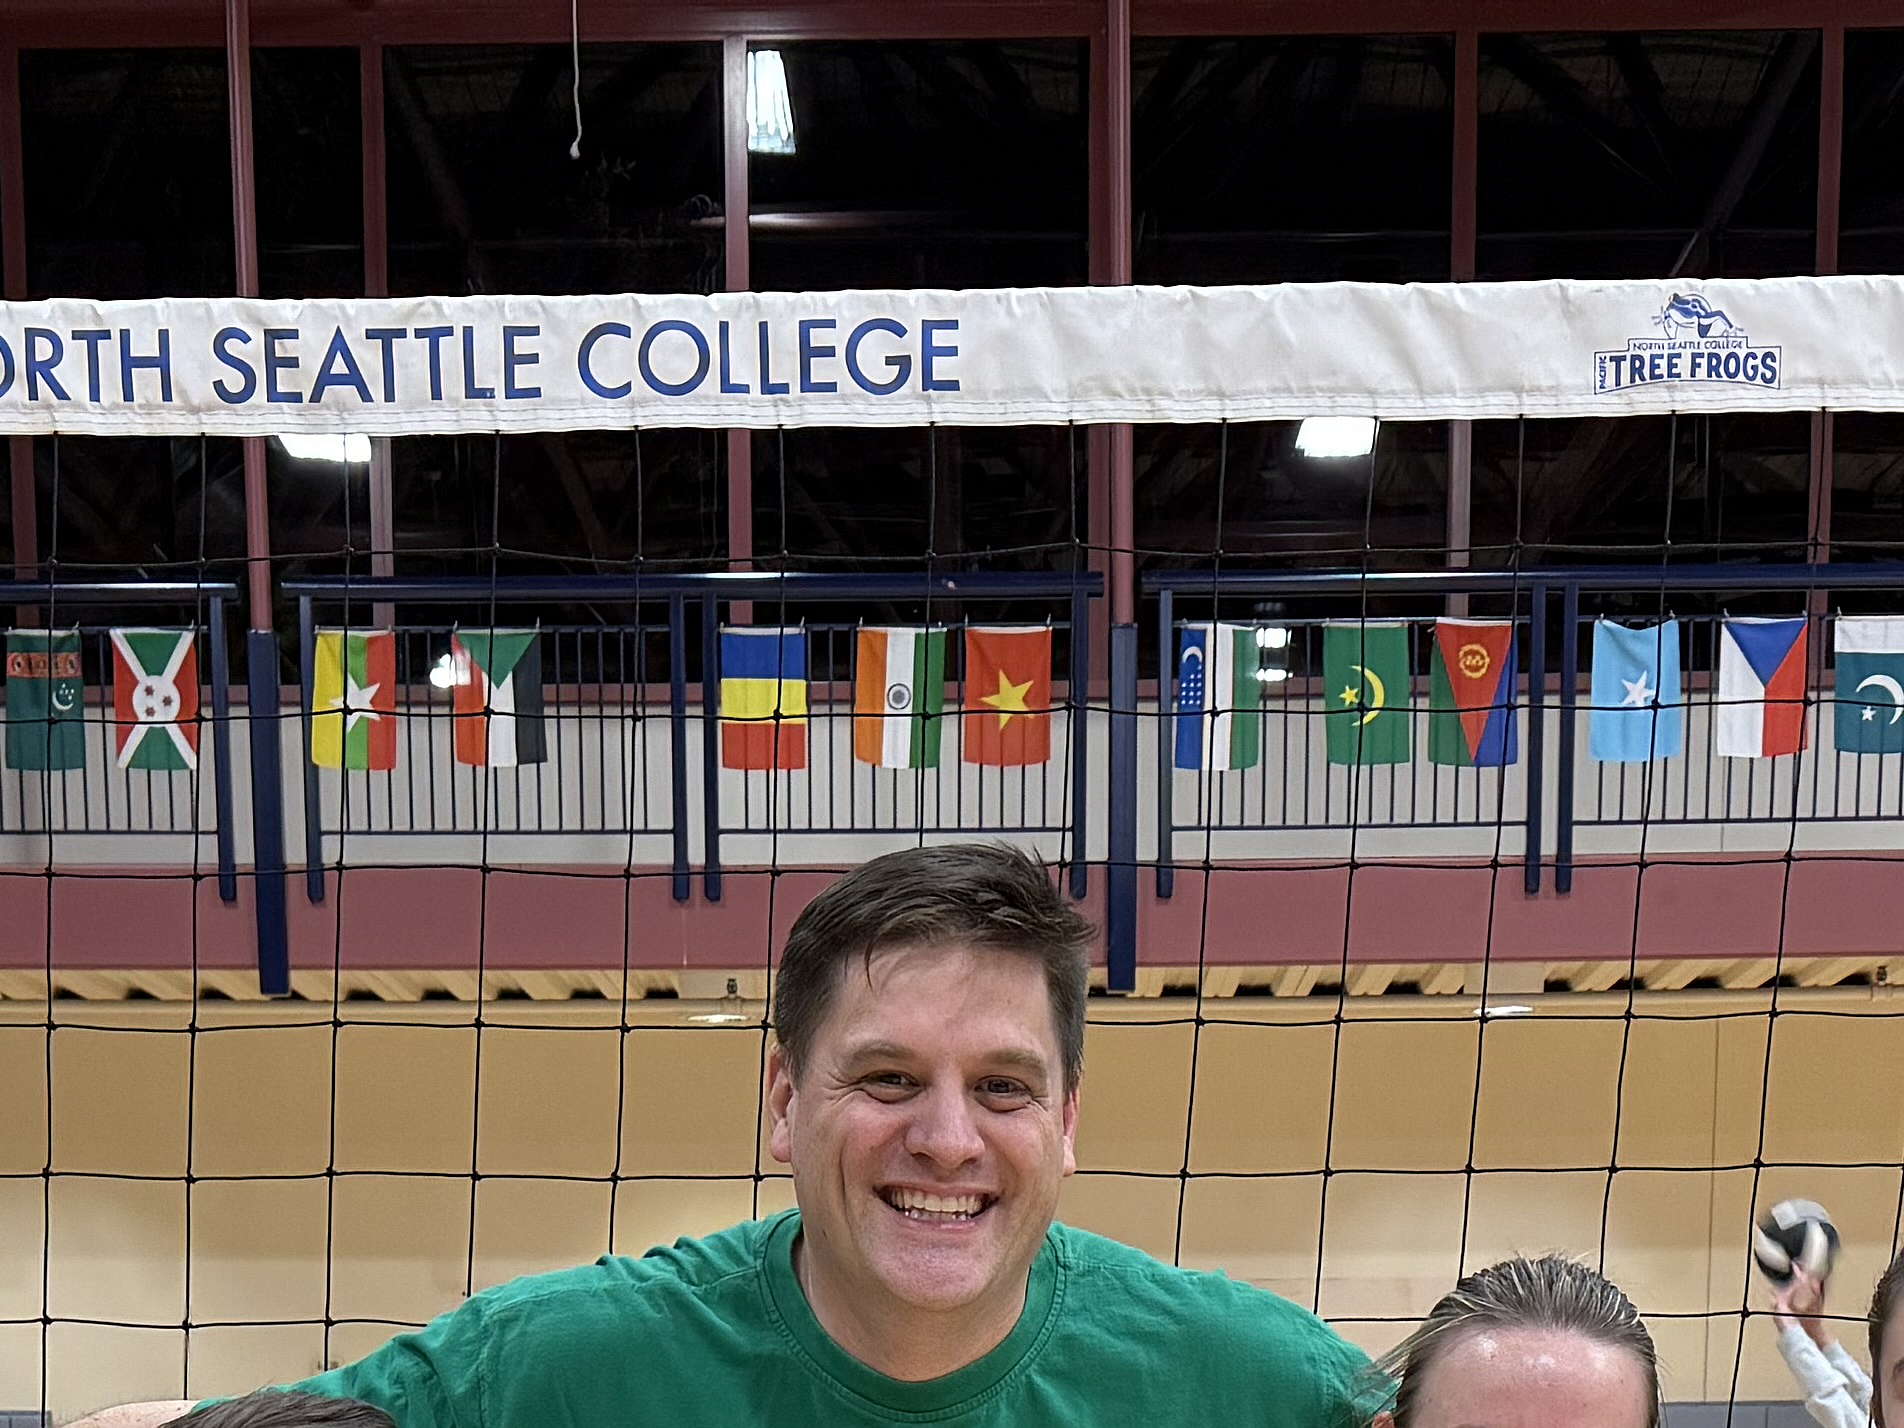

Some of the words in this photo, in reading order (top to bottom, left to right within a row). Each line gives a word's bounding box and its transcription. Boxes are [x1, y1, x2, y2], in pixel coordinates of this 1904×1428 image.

[214, 326, 543, 405] SEATTLE
[578, 318, 961, 401] COLLEGE
[1632, 341, 1665, 351] NORTH
[1704, 340, 1744, 350] COLLEGE
[1609, 352, 1682, 387] TREE
[1690, 351, 1777, 384] FROGS
